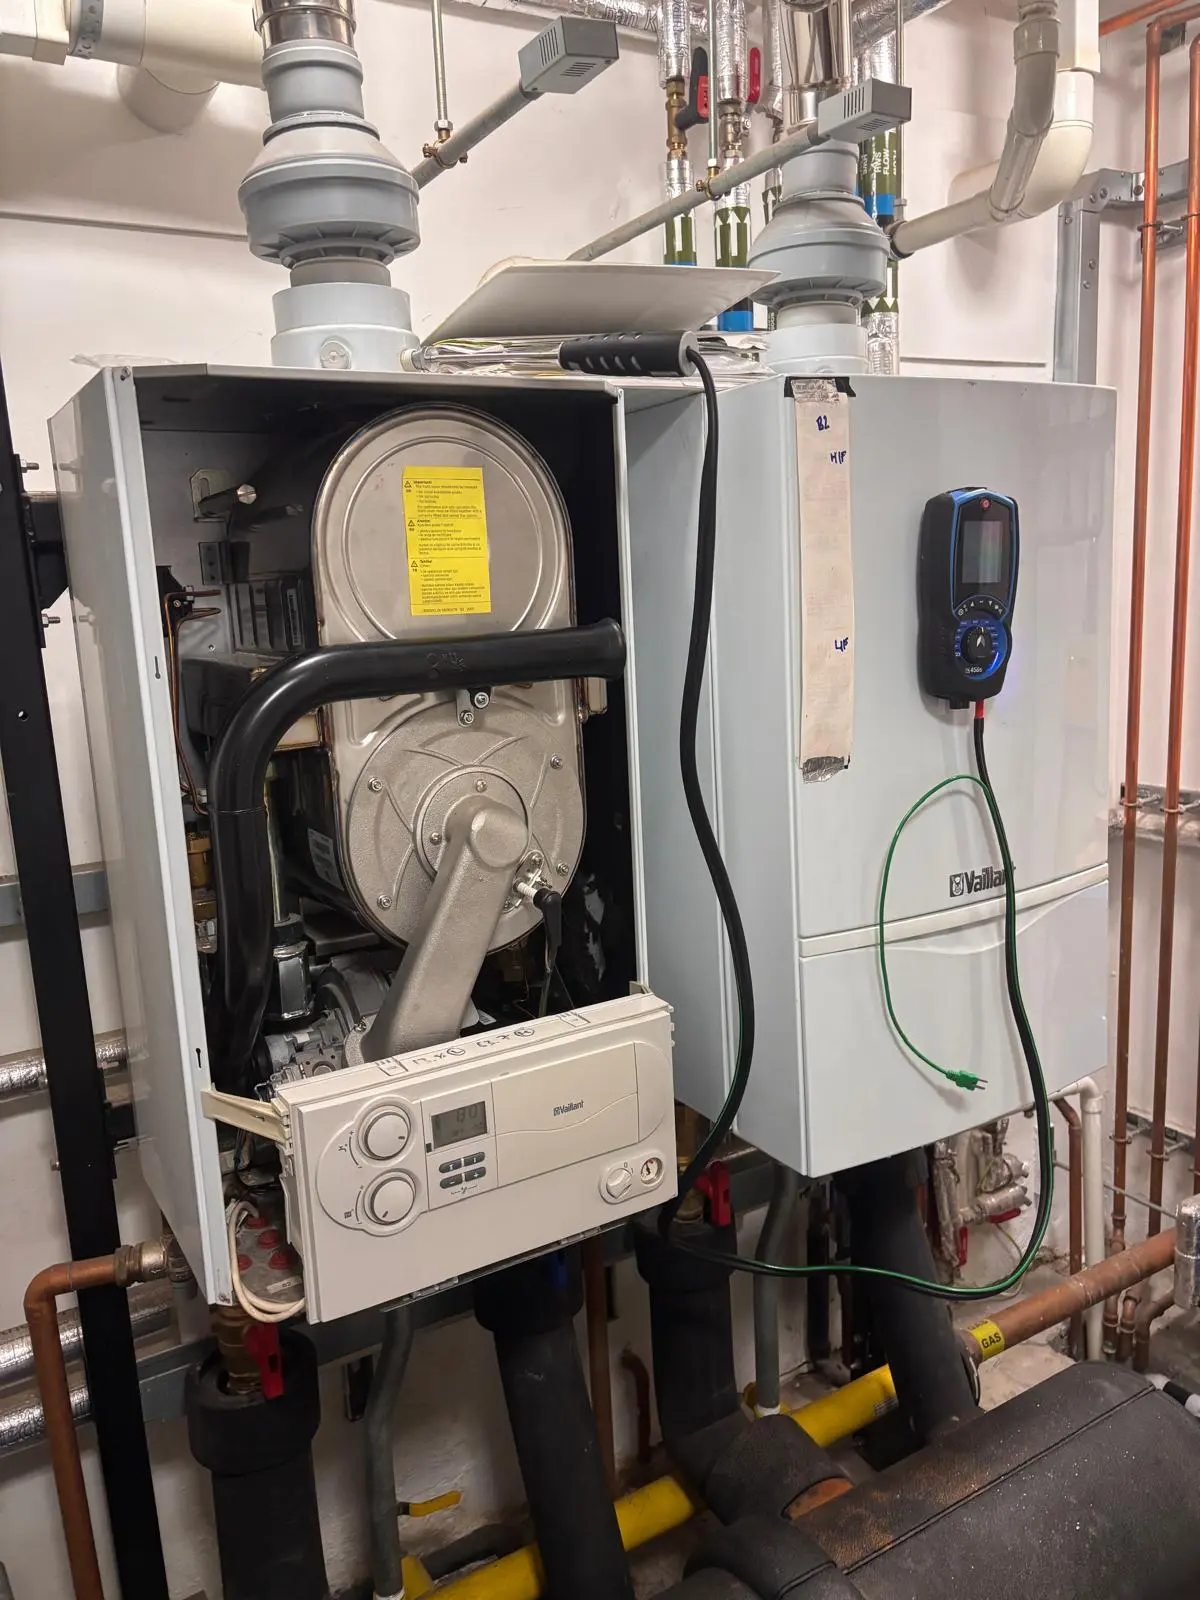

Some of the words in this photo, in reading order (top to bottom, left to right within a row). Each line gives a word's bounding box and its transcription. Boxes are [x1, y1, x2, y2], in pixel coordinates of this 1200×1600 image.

[882, 148, 890, 175] FLOW
[560, 1099, 584, 1114] Vaillant
[981, 1332, 1002, 1348] GAS
